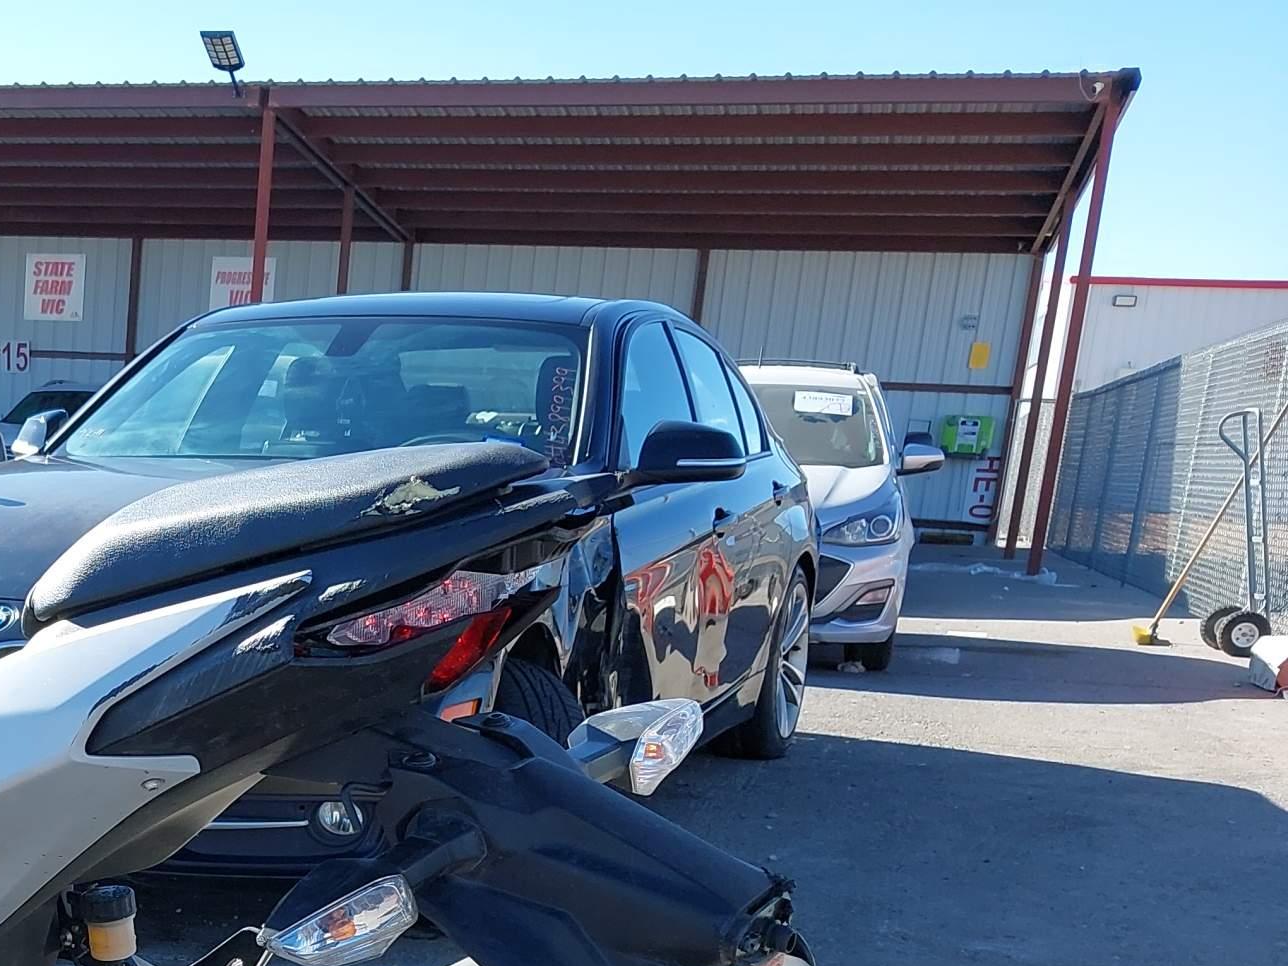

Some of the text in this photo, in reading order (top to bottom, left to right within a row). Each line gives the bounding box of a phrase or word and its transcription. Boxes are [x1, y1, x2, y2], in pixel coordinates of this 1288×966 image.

[33, 261, 75, 277] STATE
[215, 271, 270, 285] PROGRESE
[33, 280, 73, 296] FARM
[40, 298, 66, 315] VIC
[2, 342, 28, 371] 15
